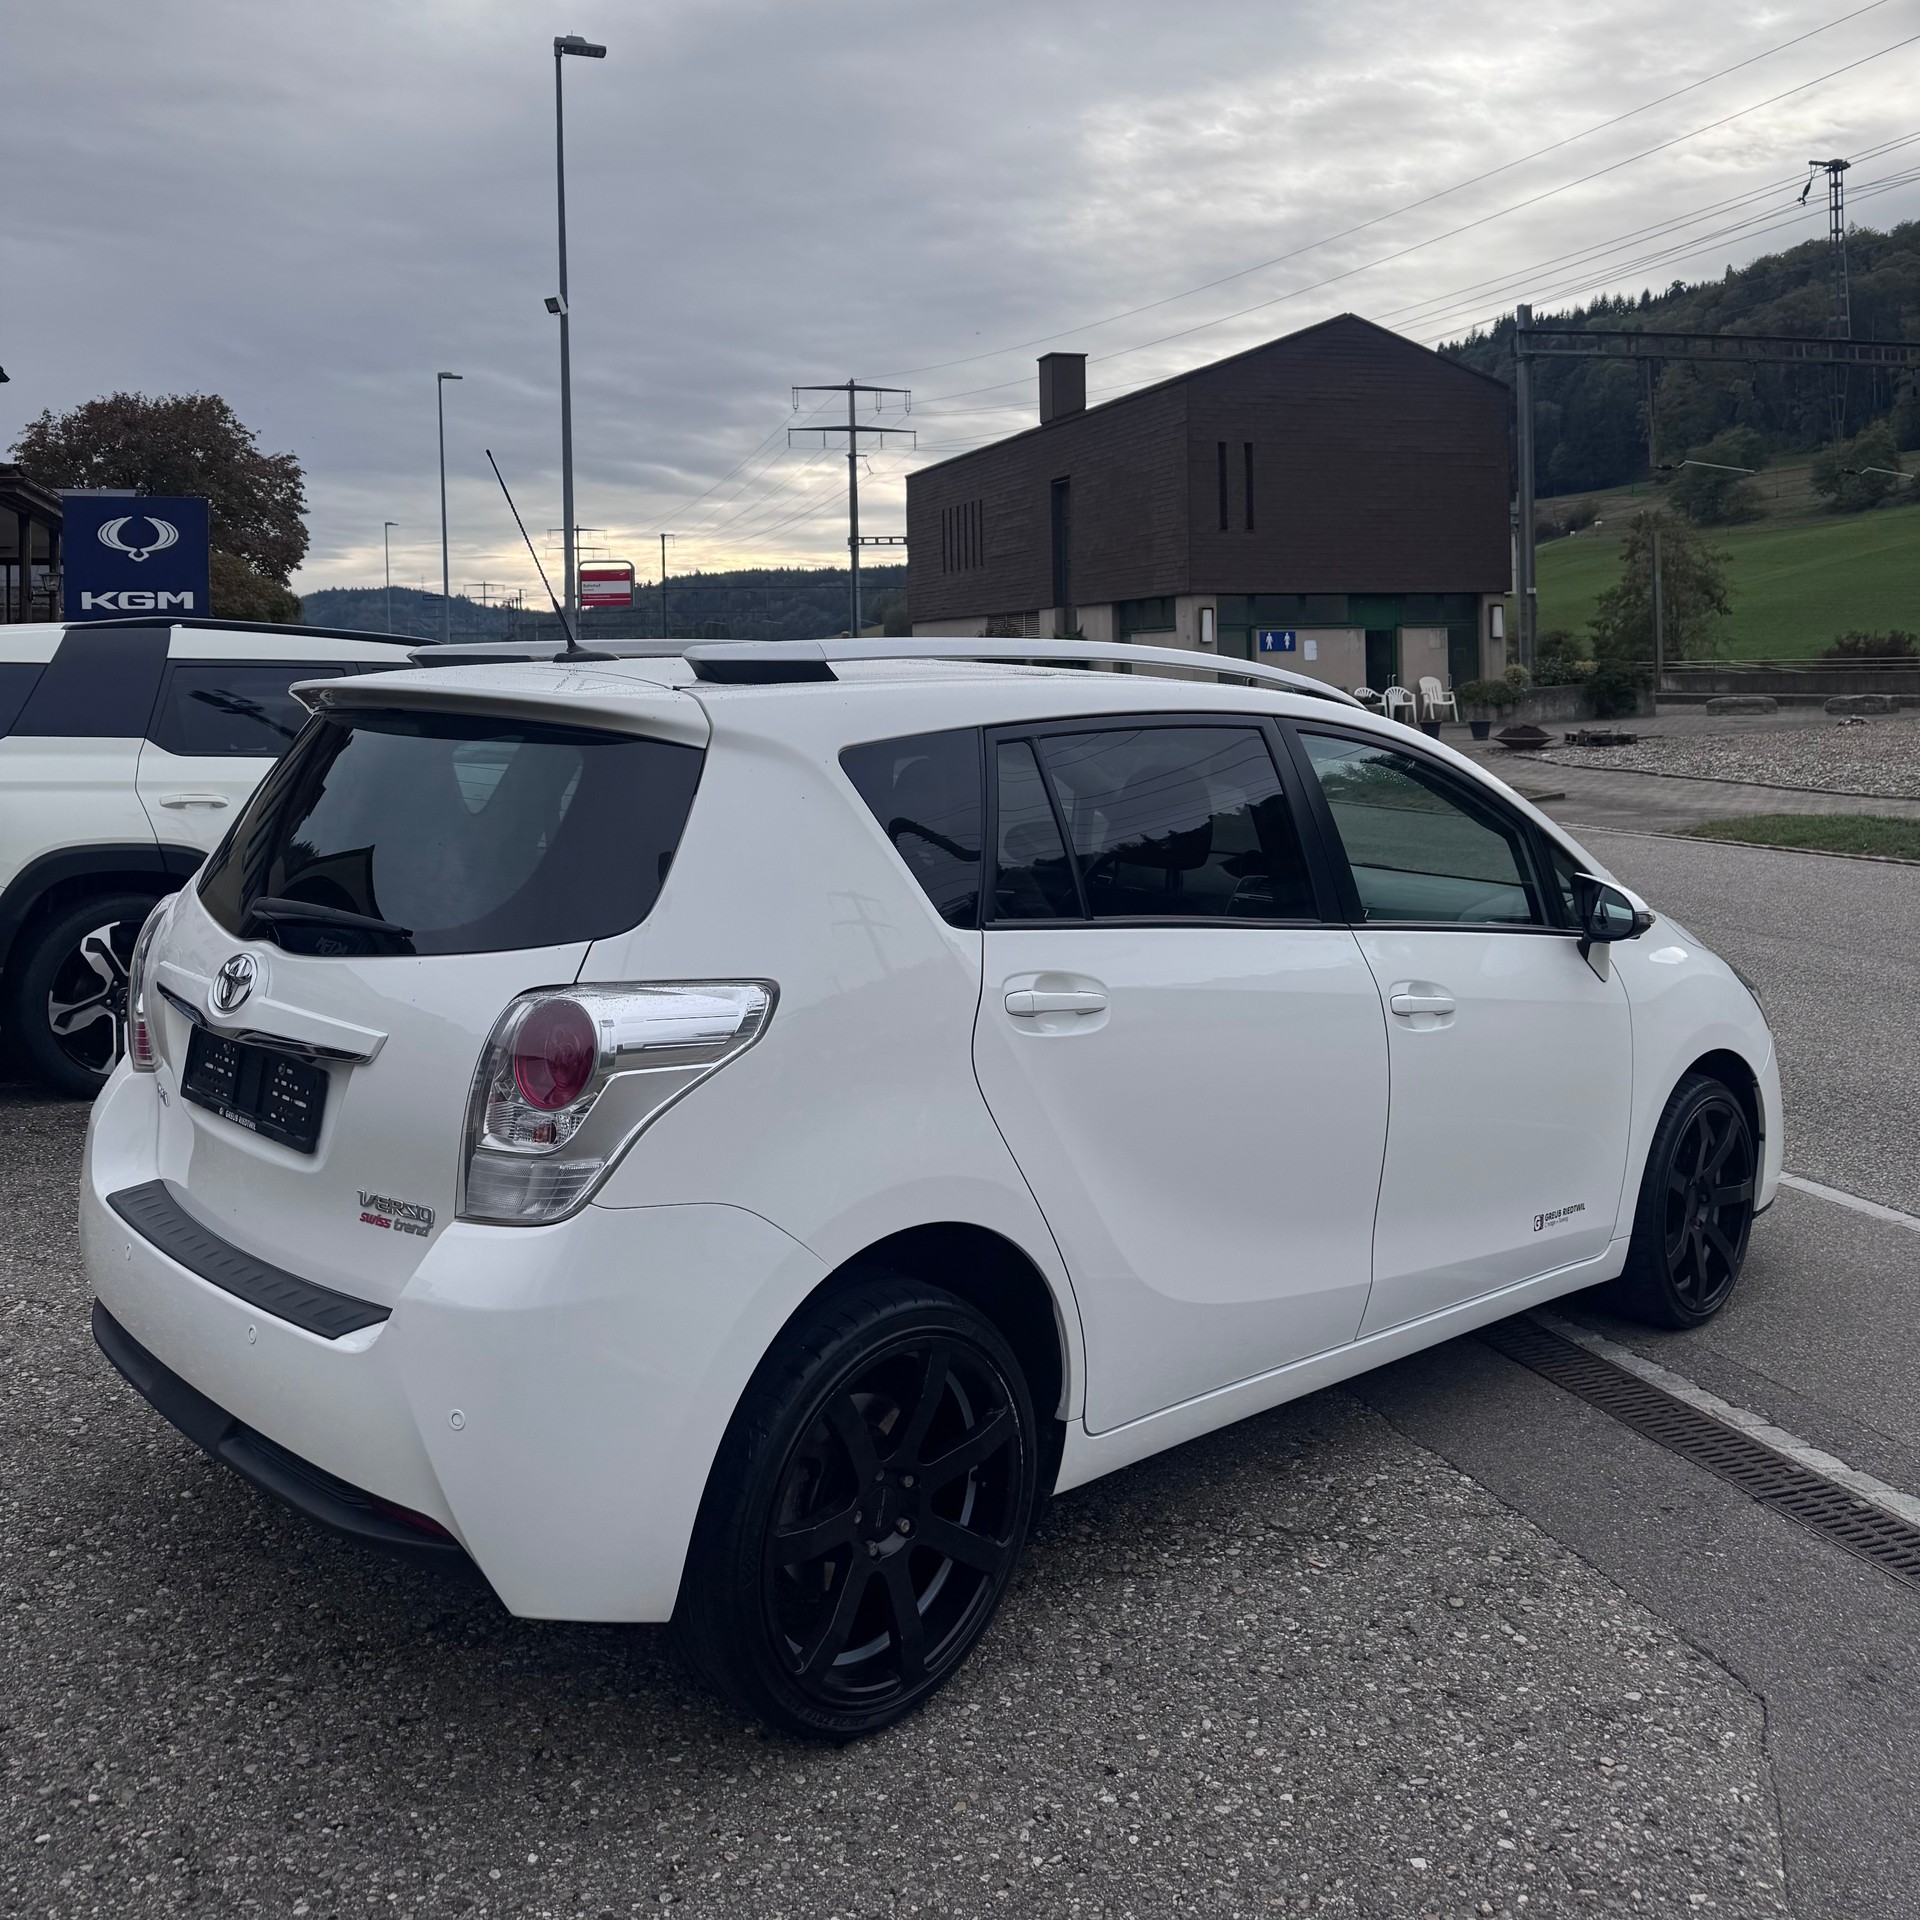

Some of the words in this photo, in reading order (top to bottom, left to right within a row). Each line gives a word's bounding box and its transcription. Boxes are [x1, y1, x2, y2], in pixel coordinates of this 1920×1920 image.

[81, 591, 194, 610] KGM
[356, 1189, 436, 1225] VERSO
[359, 1212, 393, 1229] swiss
[393, 1218, 434, 1238] trend
